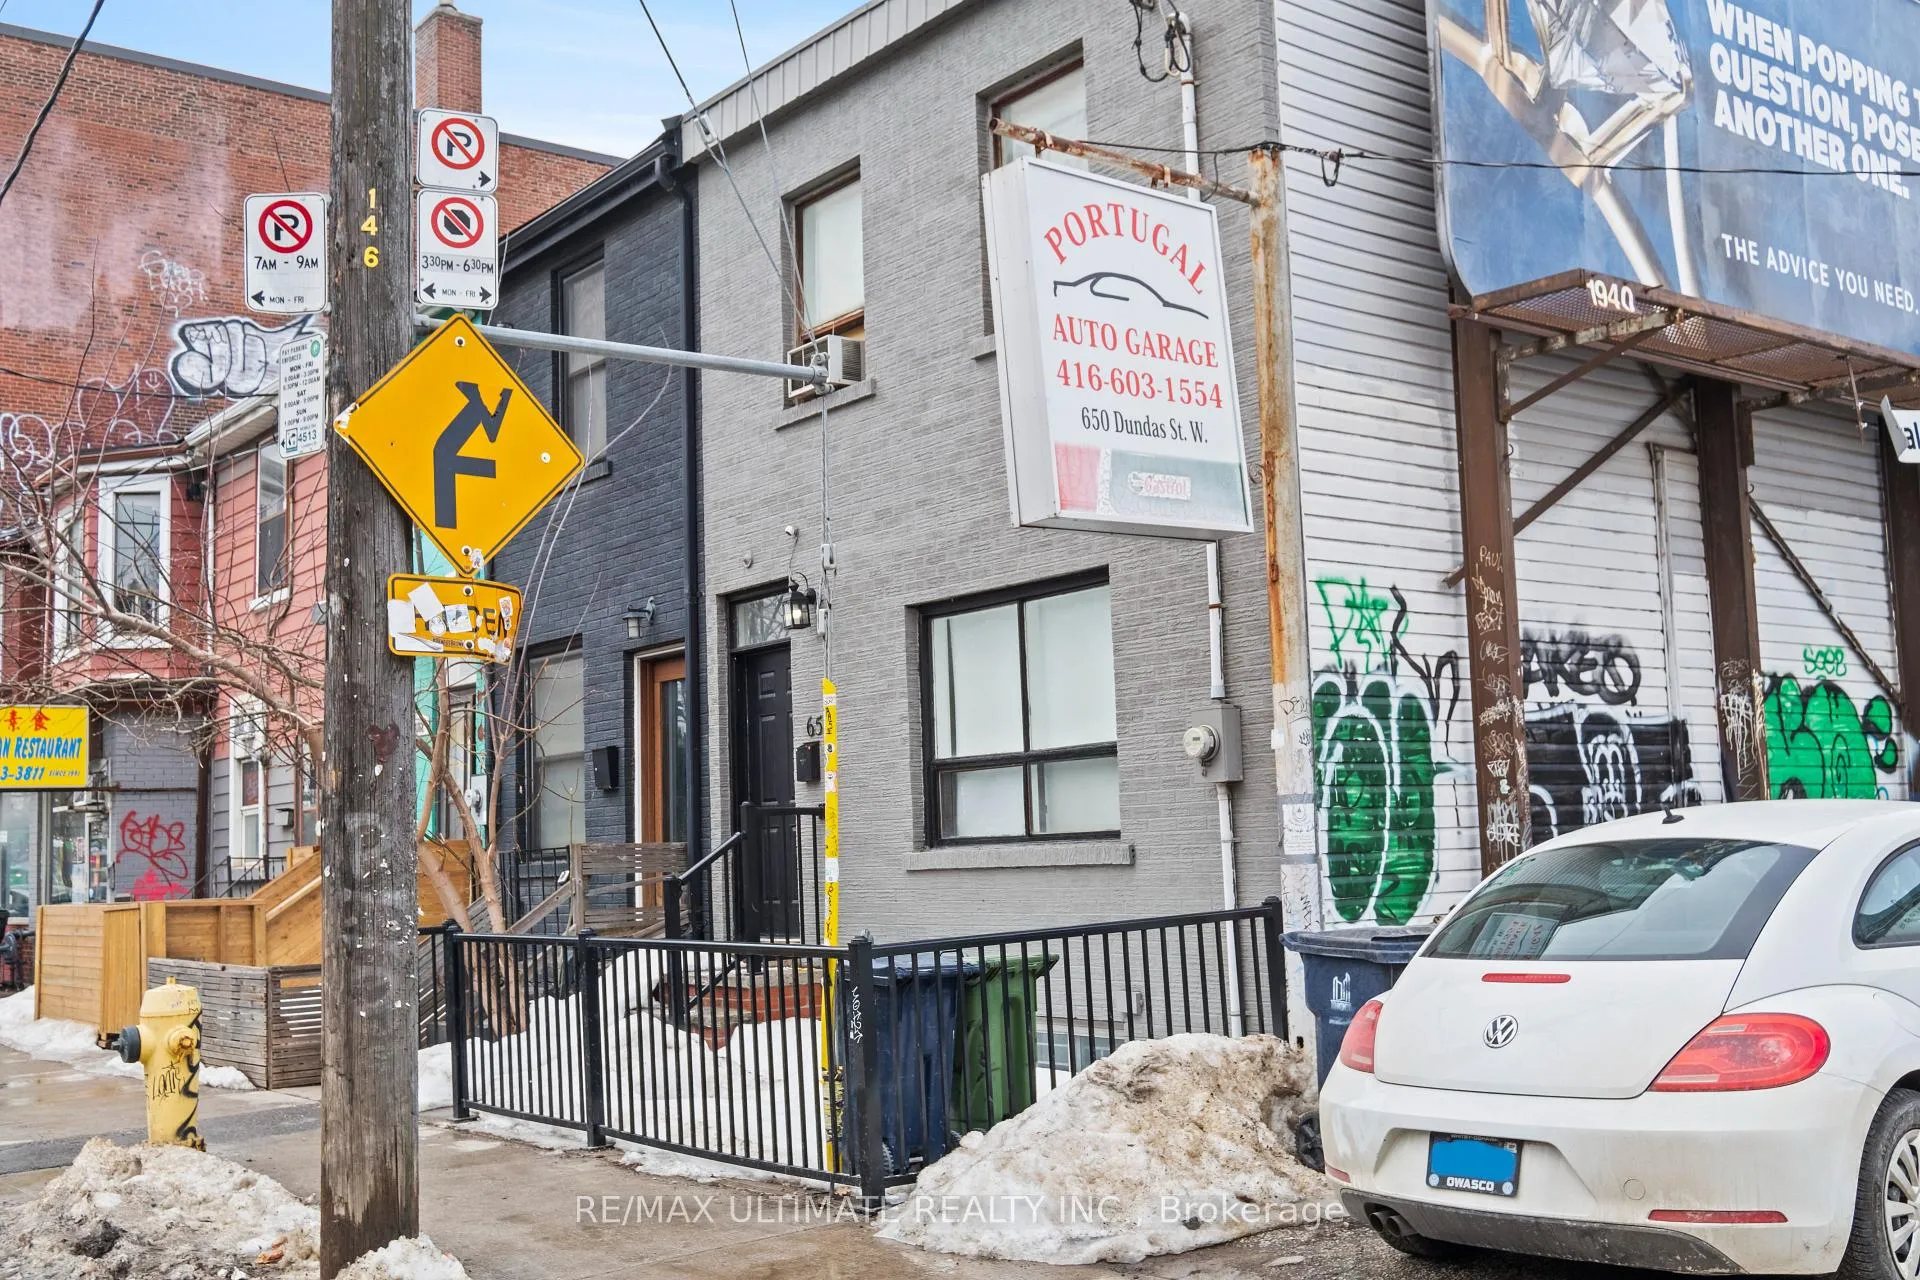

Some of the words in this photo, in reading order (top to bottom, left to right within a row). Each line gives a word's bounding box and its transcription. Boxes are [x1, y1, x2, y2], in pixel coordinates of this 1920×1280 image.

[1706, 0, 1794, 66] WHEN
[1799, 34, 1910, 117] POPPING
[1710, 42, 1858, 142] QUESTION,
[1714, 89, 1847, 173] ANOTHER
[1851, 144, 1910, 199] ONE.
[254, 256, 277, 270] 7AM
[297, 255, 318, 269] 9AM
[1044, 202, 1206, 295] PORTUGAL
[1721, 233, 1760, 266] THE
[1766, 246, 1830, 287] ADVICE
[1835, 267, 1869, 298] YOU
[1874, 280, 1919, 315] NEED.
[269, 295, 285, 304] MON
[442, 288, 457, 296] MON
[465, 289, 476, 297] FRI
[1586, 279, 1635, 313] 1940
[1053, 313, 1118, 351] AUTO
[1125, 327, 1219, 368] GARAGE
[297, 389, 306, 397] SAT
[1056, 359, 1223, 409] 416-603-1554
[298, 429, 317, 441] 4513
[1081, 406, 1110, 431] 650
[1113, 410, 1167, 439] Dundas
[1169, 417, 1188, 441] St.
[1189, 420, 1208, 444] W.
[14, 736, 82, 759] RESTAURANT
[1446, 1176, 1495, 1191] OWASCO
